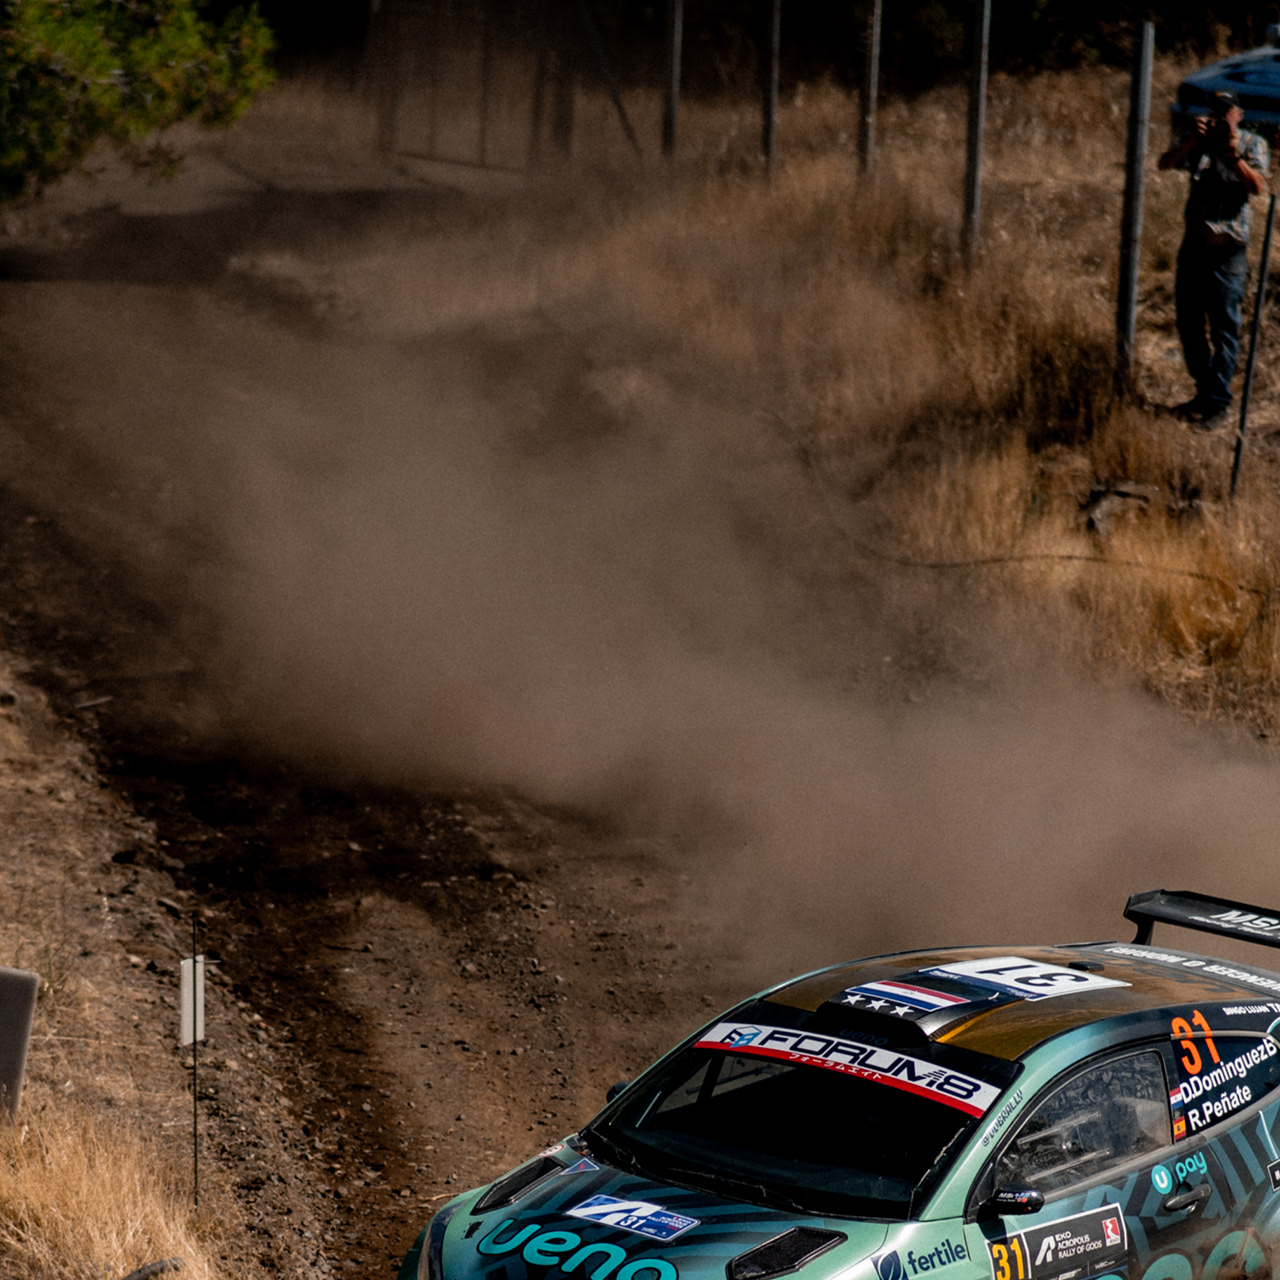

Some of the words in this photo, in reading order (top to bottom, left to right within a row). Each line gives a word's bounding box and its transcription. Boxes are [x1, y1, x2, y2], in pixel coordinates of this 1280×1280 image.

[977, 963, 1090, 988] 31
[1171, 1009, 1221, 1076] 31
[758, 1028, 982, 1101] FORUM8
[1175, 1151, 1208, 1184] pay
[620, 1216, 647, 1229] 31
[908, 1239, 967, 1275] fertile
[1057, 1234, 1091, 1251] ACROPOLIS
[1058, 1247, 1076, 1259] RALLY
[1076, 1245, 1085, 1254] OF
[1085, 1240, 1103, 1252] GODS
